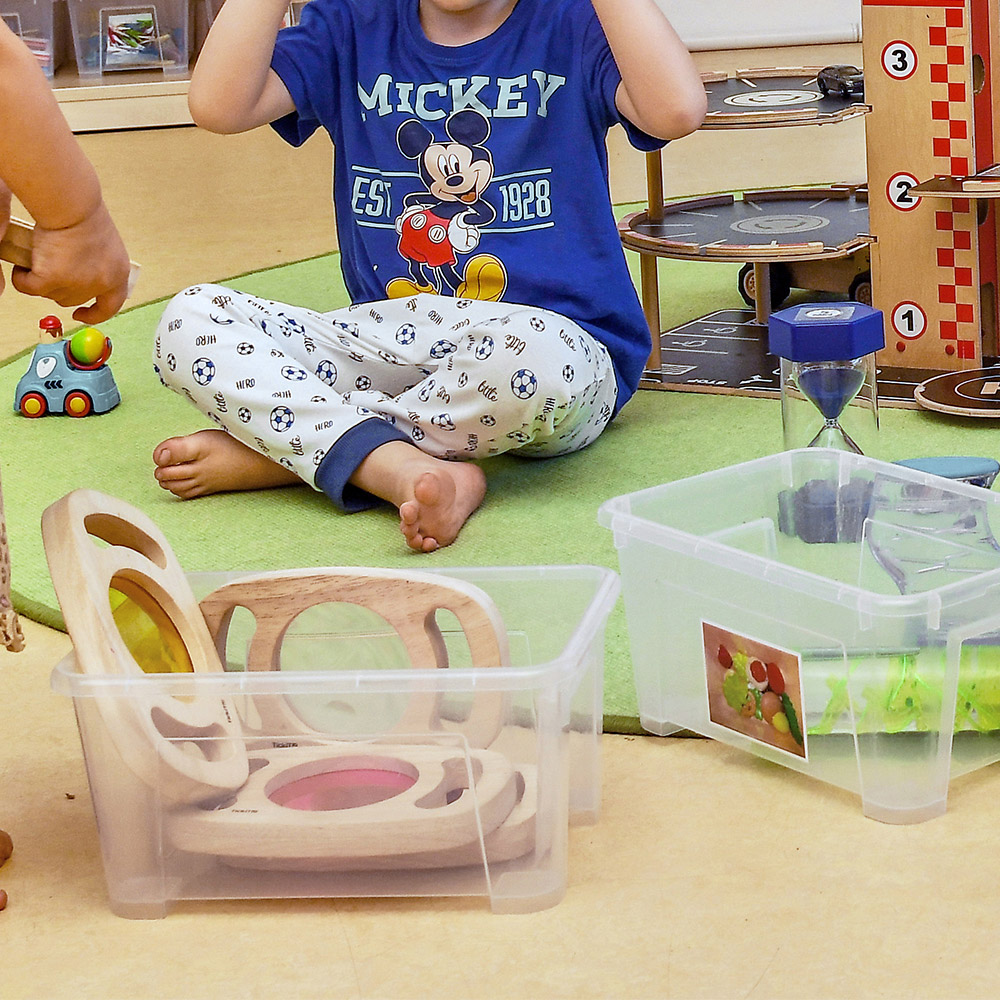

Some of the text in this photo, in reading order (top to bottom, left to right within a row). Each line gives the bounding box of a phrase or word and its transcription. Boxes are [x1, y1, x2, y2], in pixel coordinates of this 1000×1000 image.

[892, 50, 908, 72] 3
[358, 70, 566, 122] MICKEY
[351, 176, 551, 222] EST 1928
[896, 181, 913, 203] 2
[902, 310, 914, 332] 1
